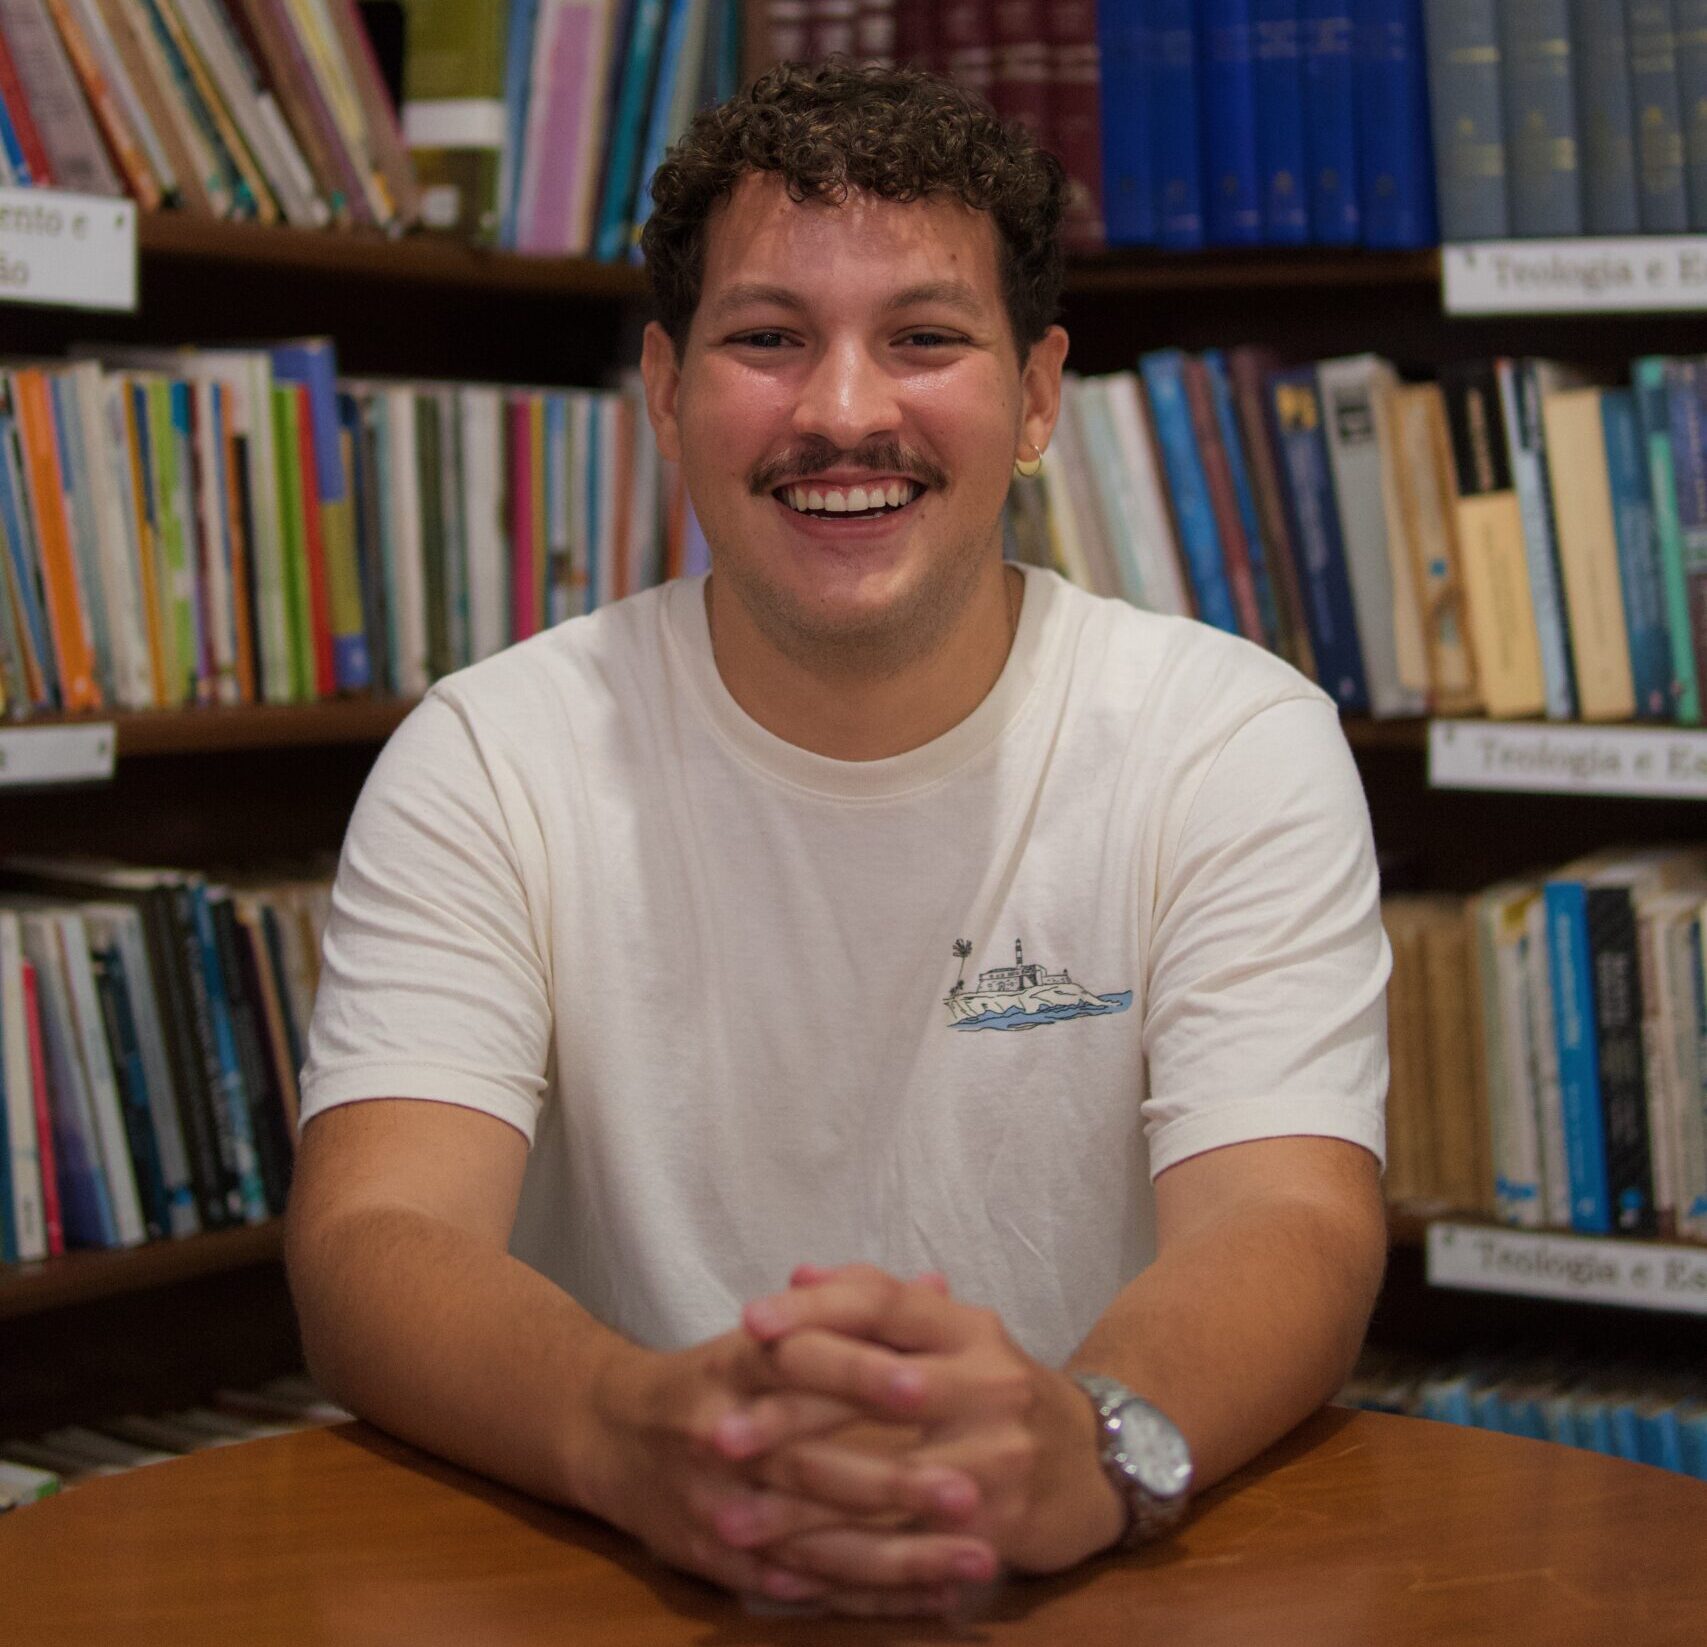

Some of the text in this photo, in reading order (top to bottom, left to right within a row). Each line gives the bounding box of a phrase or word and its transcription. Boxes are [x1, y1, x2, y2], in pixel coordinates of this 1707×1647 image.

[1492, 253, 1633, 295] Teologia
[1646, 260, 1665, 288] e
[1479, 735, 1622, 780] Teologia
[1633, 751, 1654, 777] e
[1474, 1235, 1621, 1287] Teologia
[1631, 1260, 1653, 1289] e
